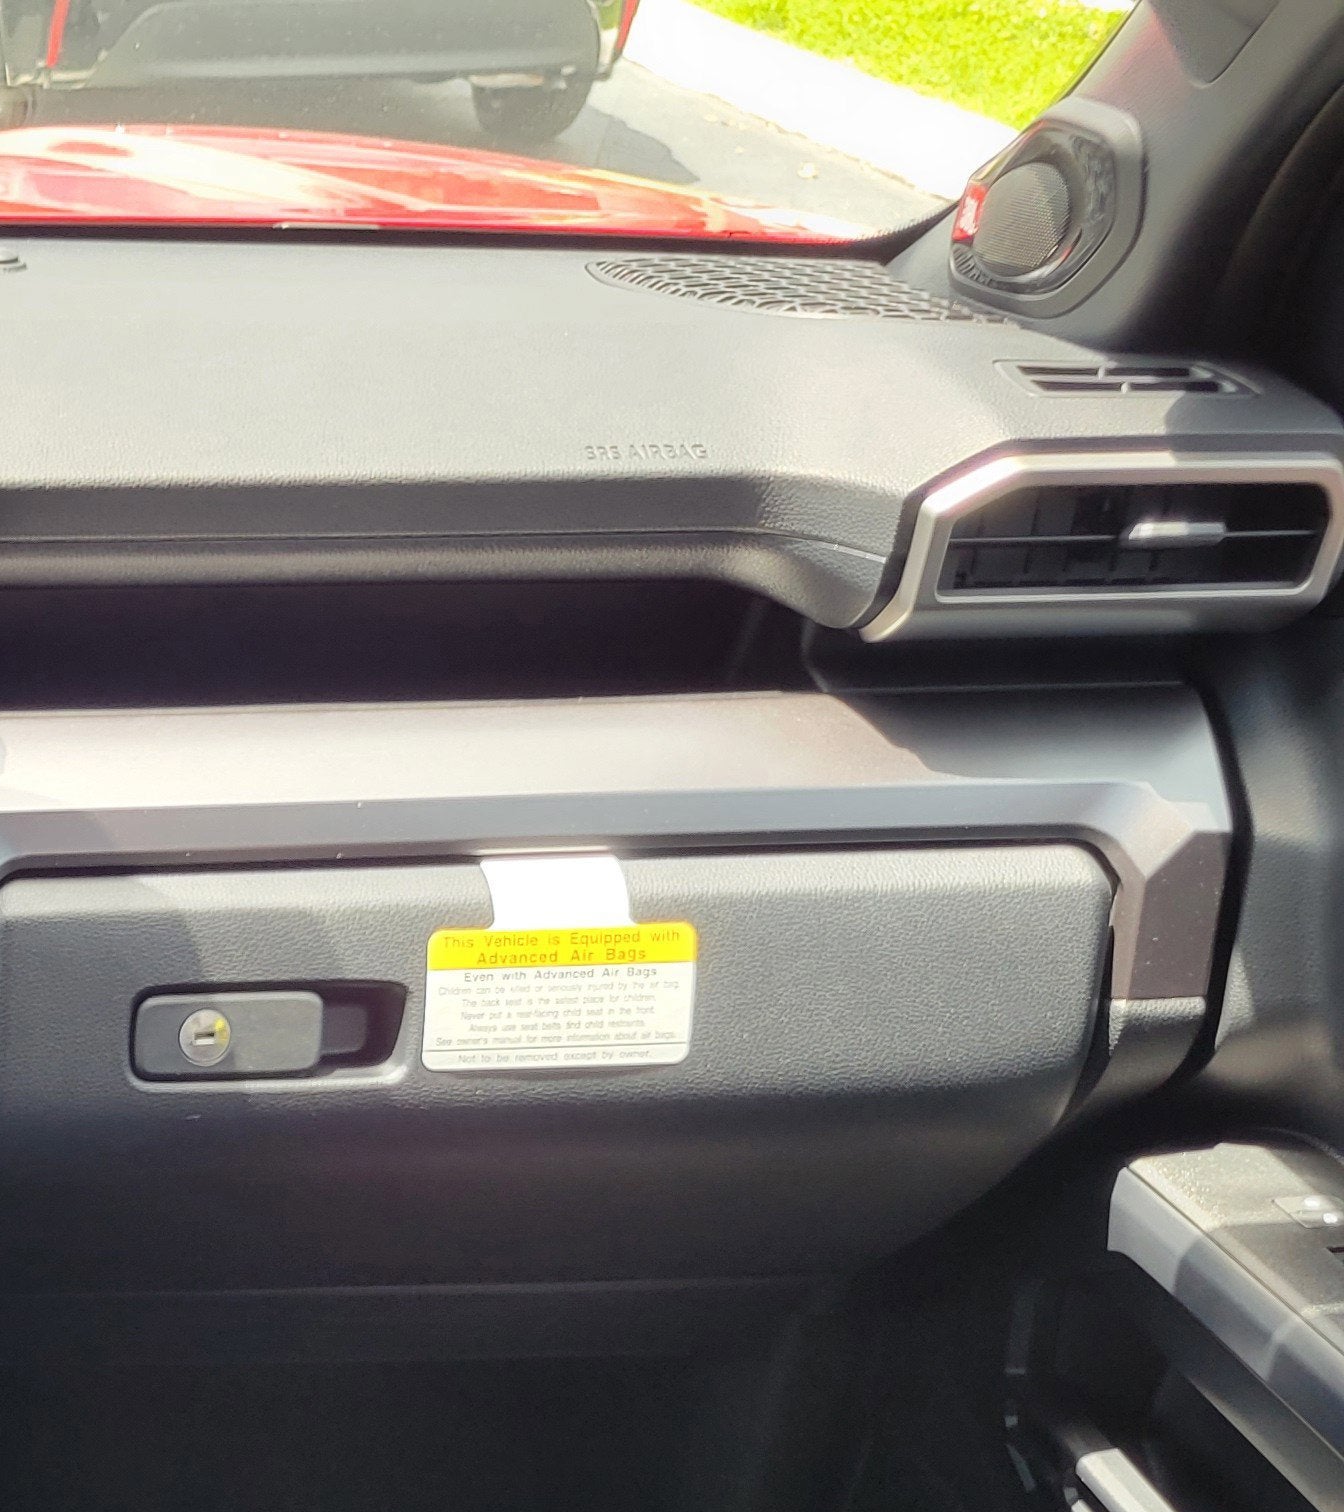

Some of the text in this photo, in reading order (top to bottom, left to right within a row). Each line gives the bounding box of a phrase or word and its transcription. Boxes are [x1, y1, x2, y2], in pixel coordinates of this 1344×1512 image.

[629, 443, 708, 460] AIRBAG
[444, 930, 681, 948] This Vehicle is Equipped with
[476, 948, 647, 965] Advanced Air Bags
[464, 967, 658, 982] Even with Advanced Air Bags
